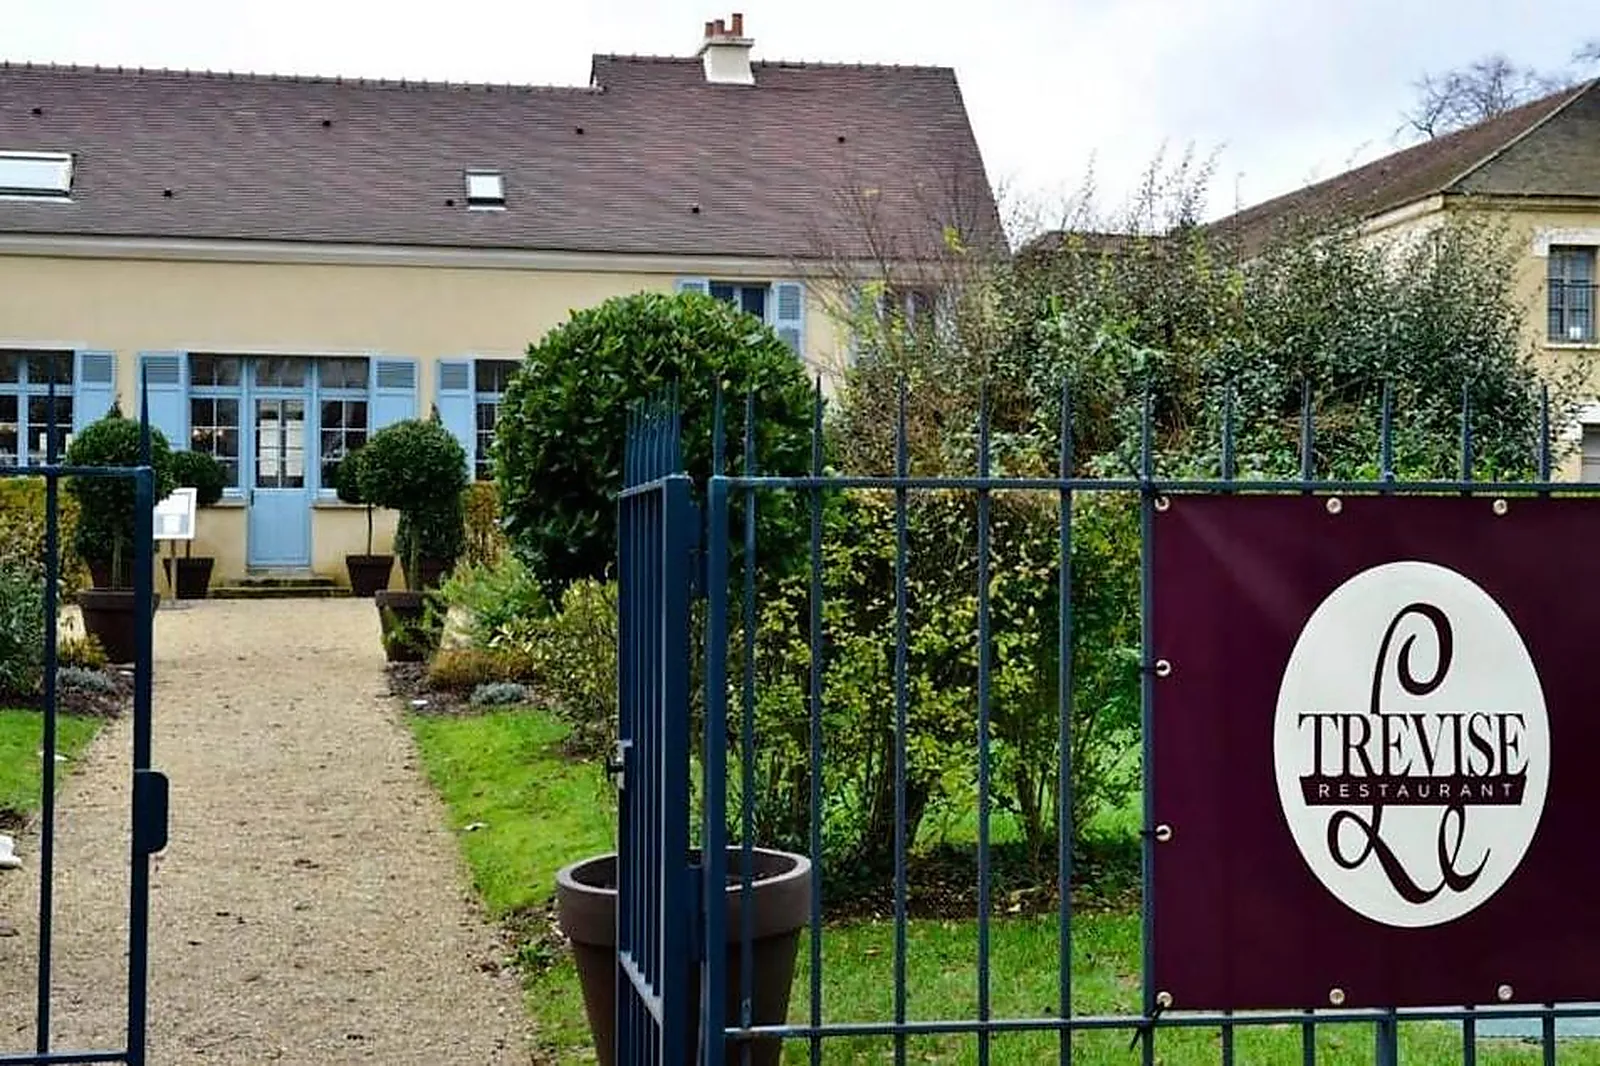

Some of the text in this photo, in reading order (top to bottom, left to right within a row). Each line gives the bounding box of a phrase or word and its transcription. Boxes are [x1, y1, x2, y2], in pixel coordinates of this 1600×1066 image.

[1298, 713, 1529, 777] TREVISE
[1327, 603, 1491, 904] Le
[1318, 784, 1514, 798] RESTAURANT
